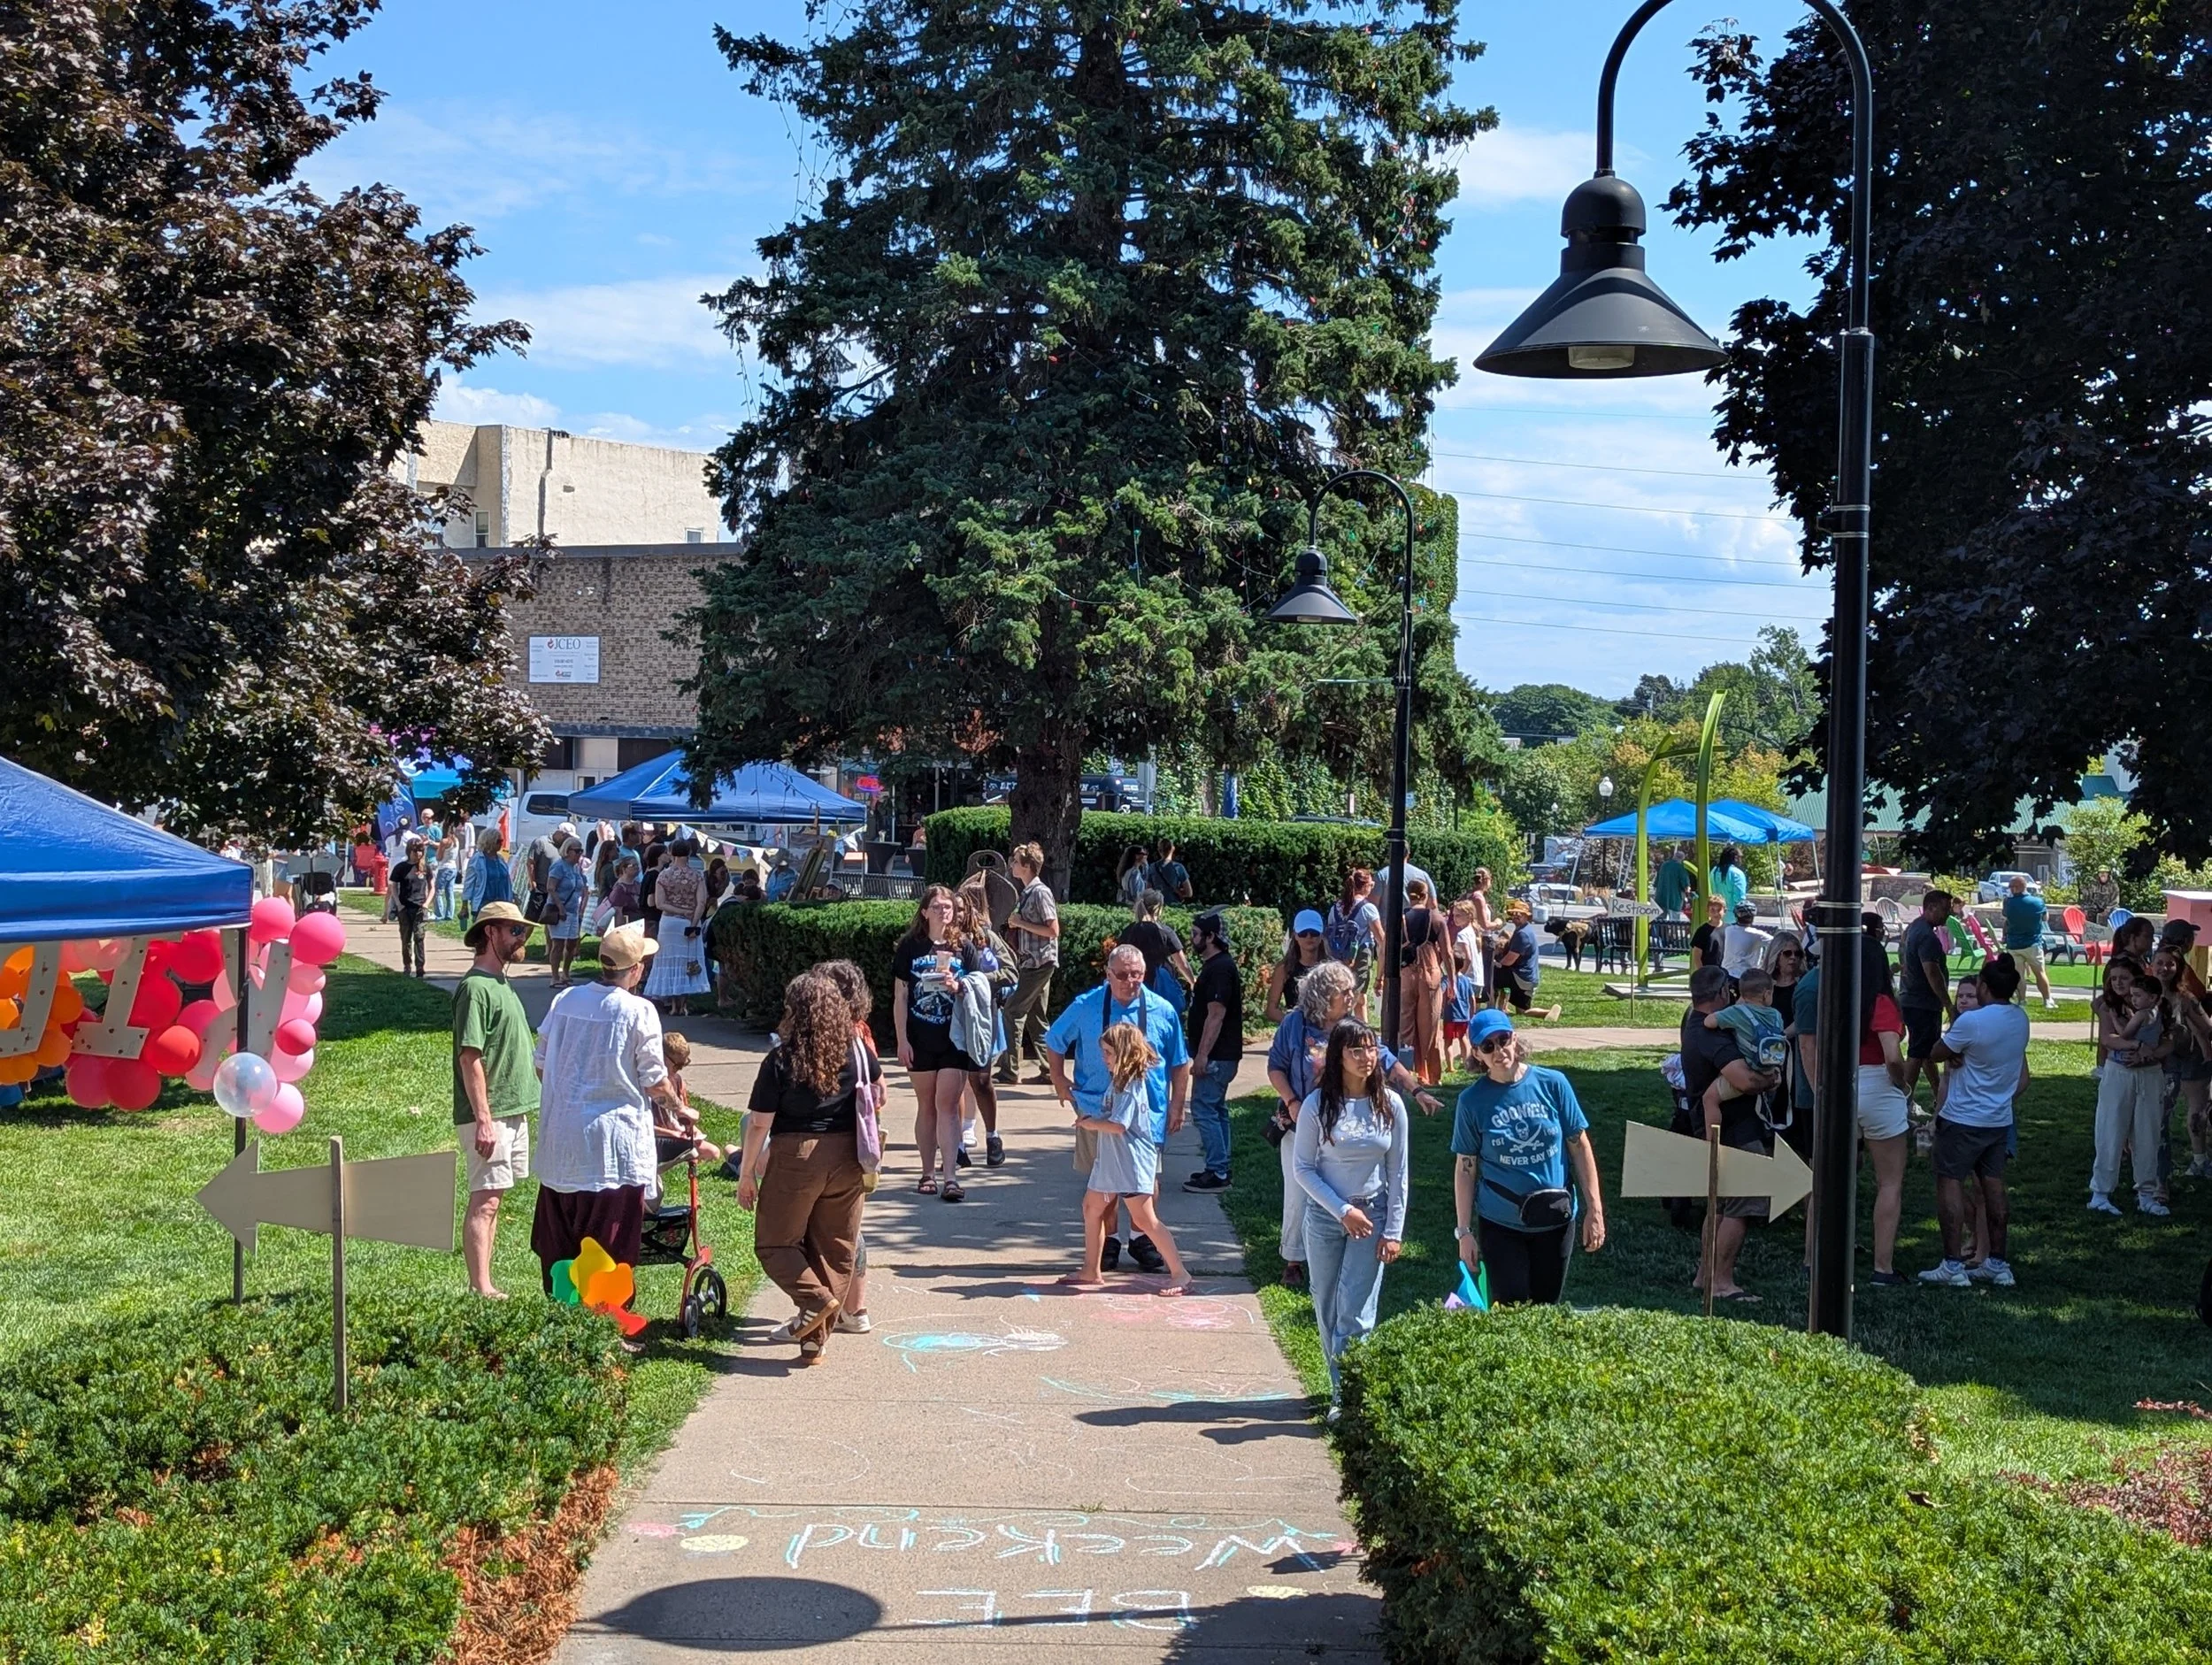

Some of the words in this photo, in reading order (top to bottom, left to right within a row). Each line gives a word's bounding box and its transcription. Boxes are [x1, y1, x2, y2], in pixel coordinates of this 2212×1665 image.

[554, 638, 580, 649] JCEO
[1612, 899, 1660, 915] Restroom
[1499, 1154, 1529, 1165] NEVER
[1530, 1151, 1546, 1164] SAY
[785, 1522, 1325, 1572] Weekend
[911, 1587, 1199, 1631] BEE
